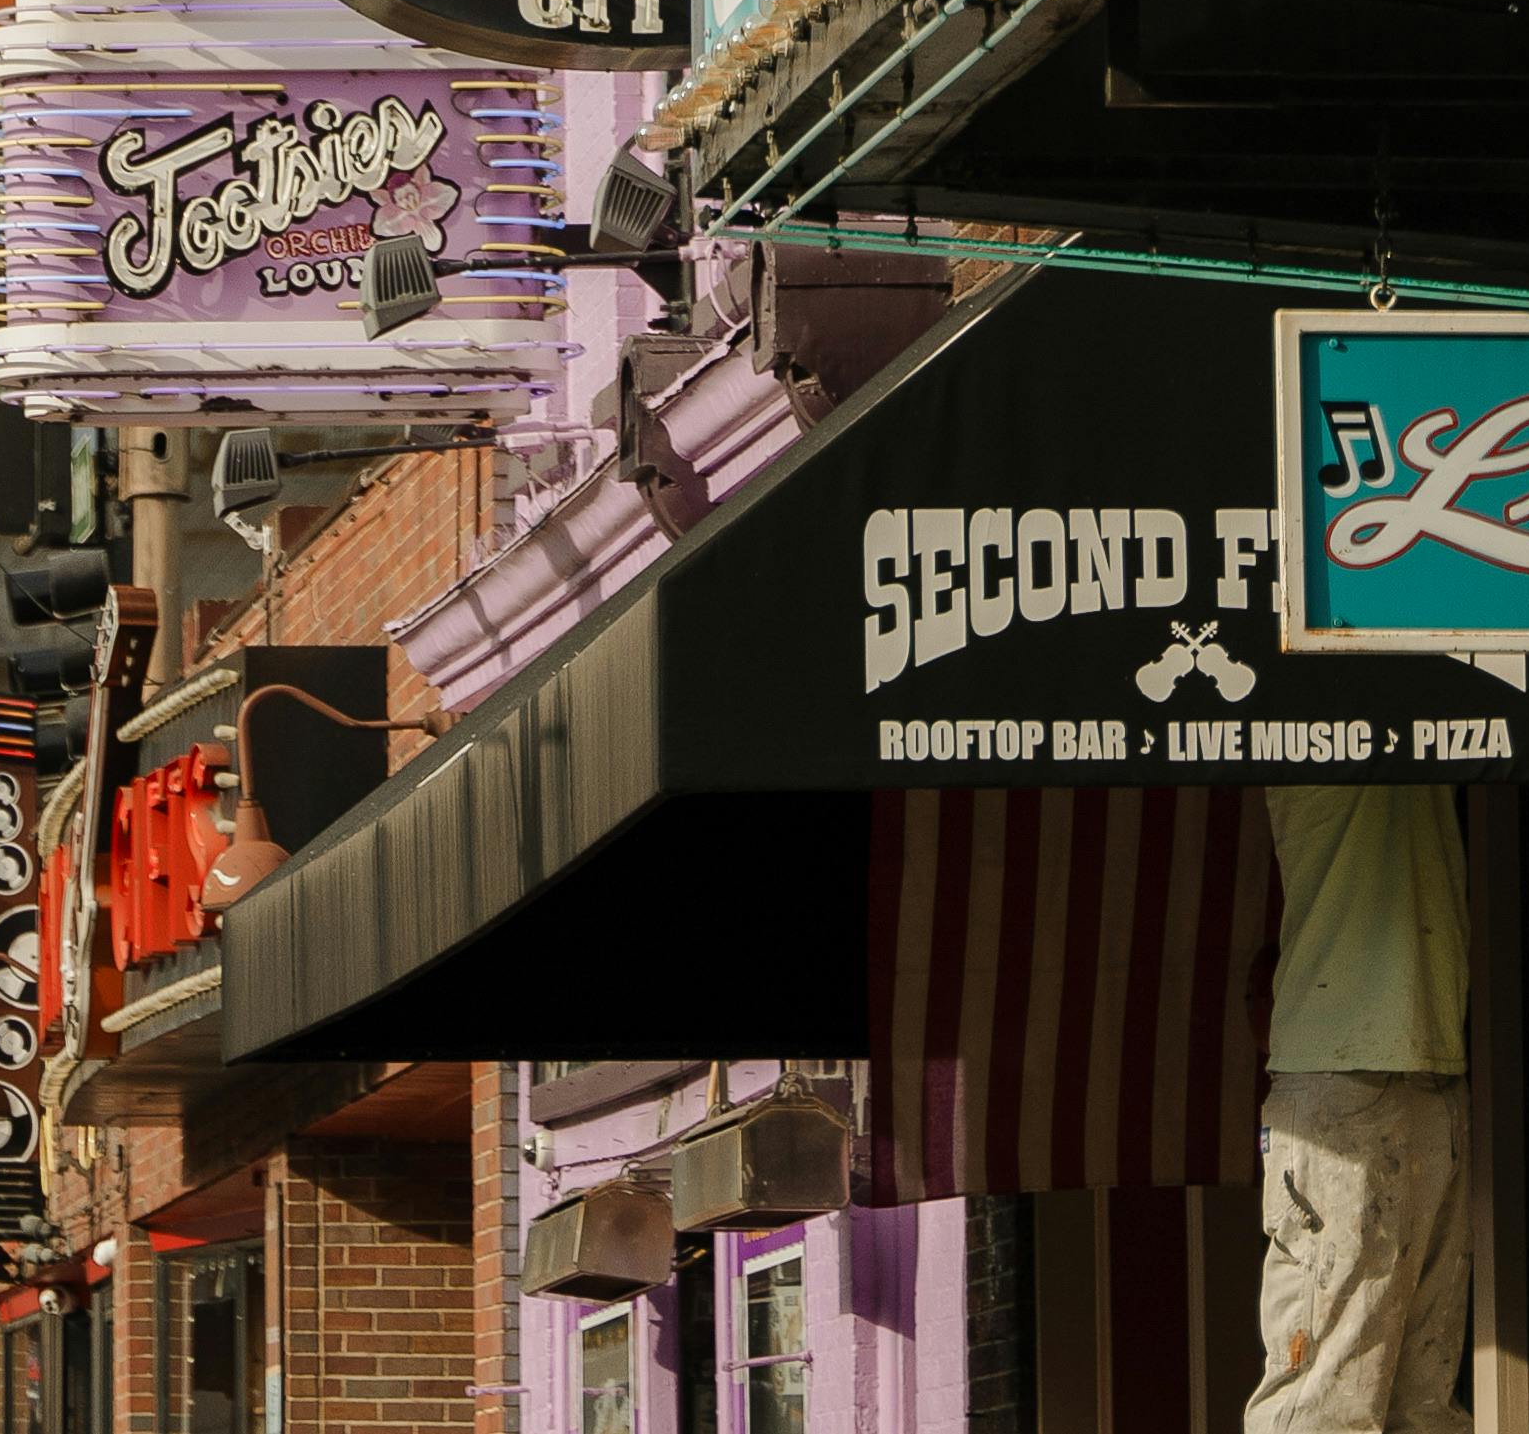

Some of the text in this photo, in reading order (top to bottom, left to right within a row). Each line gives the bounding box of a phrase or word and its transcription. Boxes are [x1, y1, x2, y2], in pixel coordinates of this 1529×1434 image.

[98, 95, 455, 302] Tootsies
[863, 507, 1189, 696] SECOND
[879, 718, 1513, 763] ROOFTOP BAR LIVE MUSIC PIZZA
